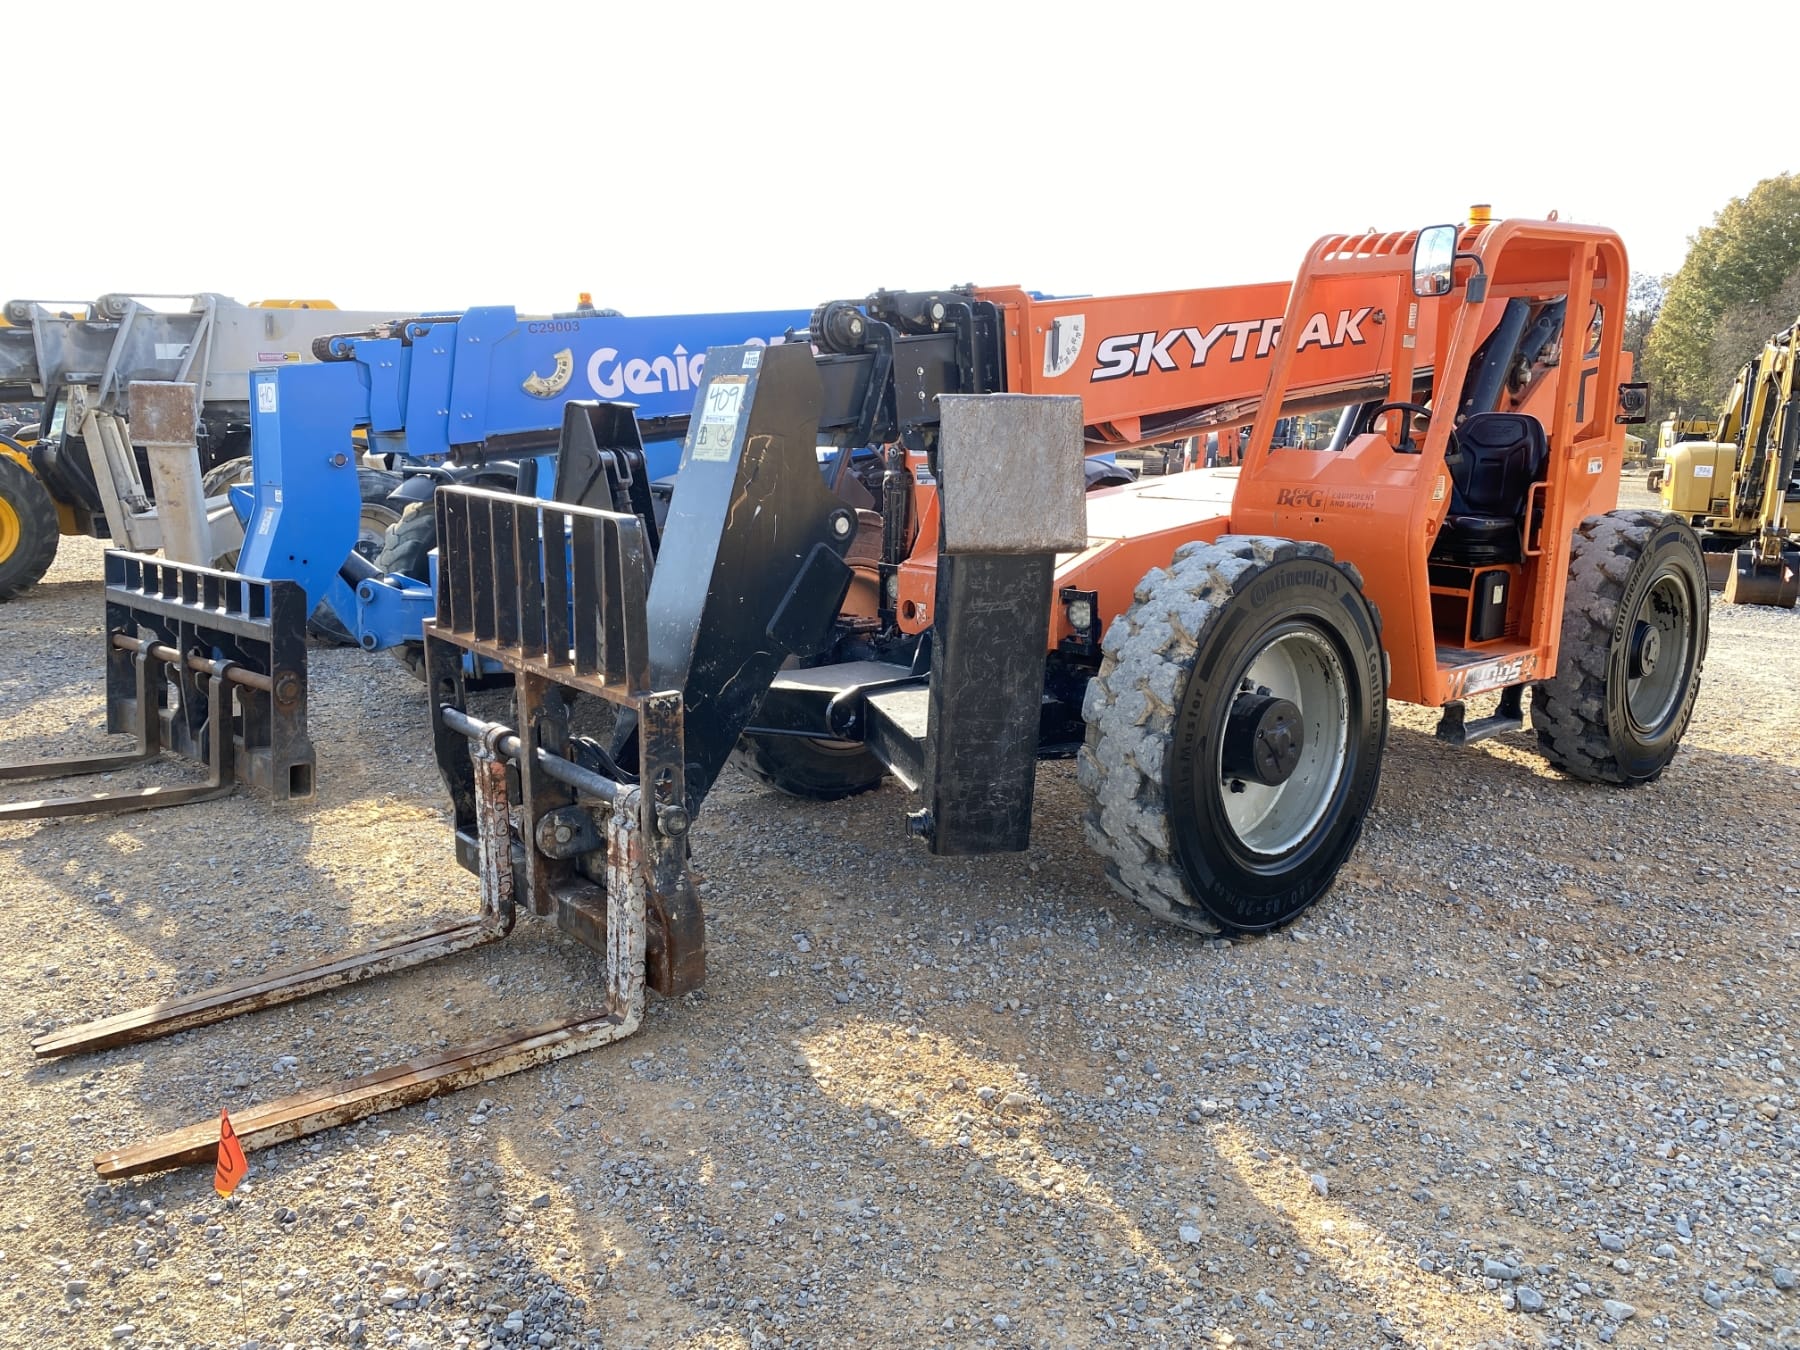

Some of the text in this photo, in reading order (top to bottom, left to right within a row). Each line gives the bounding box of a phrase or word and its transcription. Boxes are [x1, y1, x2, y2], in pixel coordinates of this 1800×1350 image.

[528, 321, 580, 334] C29003
[1090, 307, 1374, 383] SKYTRAK
[710, 386, 739, 413] 409
[1276, 487, 1324, 508] B&G
[1330, 500, 1374, 510] AND SUPPLY
[1332, 490, 1375, 501] EQUIPMENT
[1251, 569, 1329, 608] Continental
[1614, 558, 1647, 643] Continental
